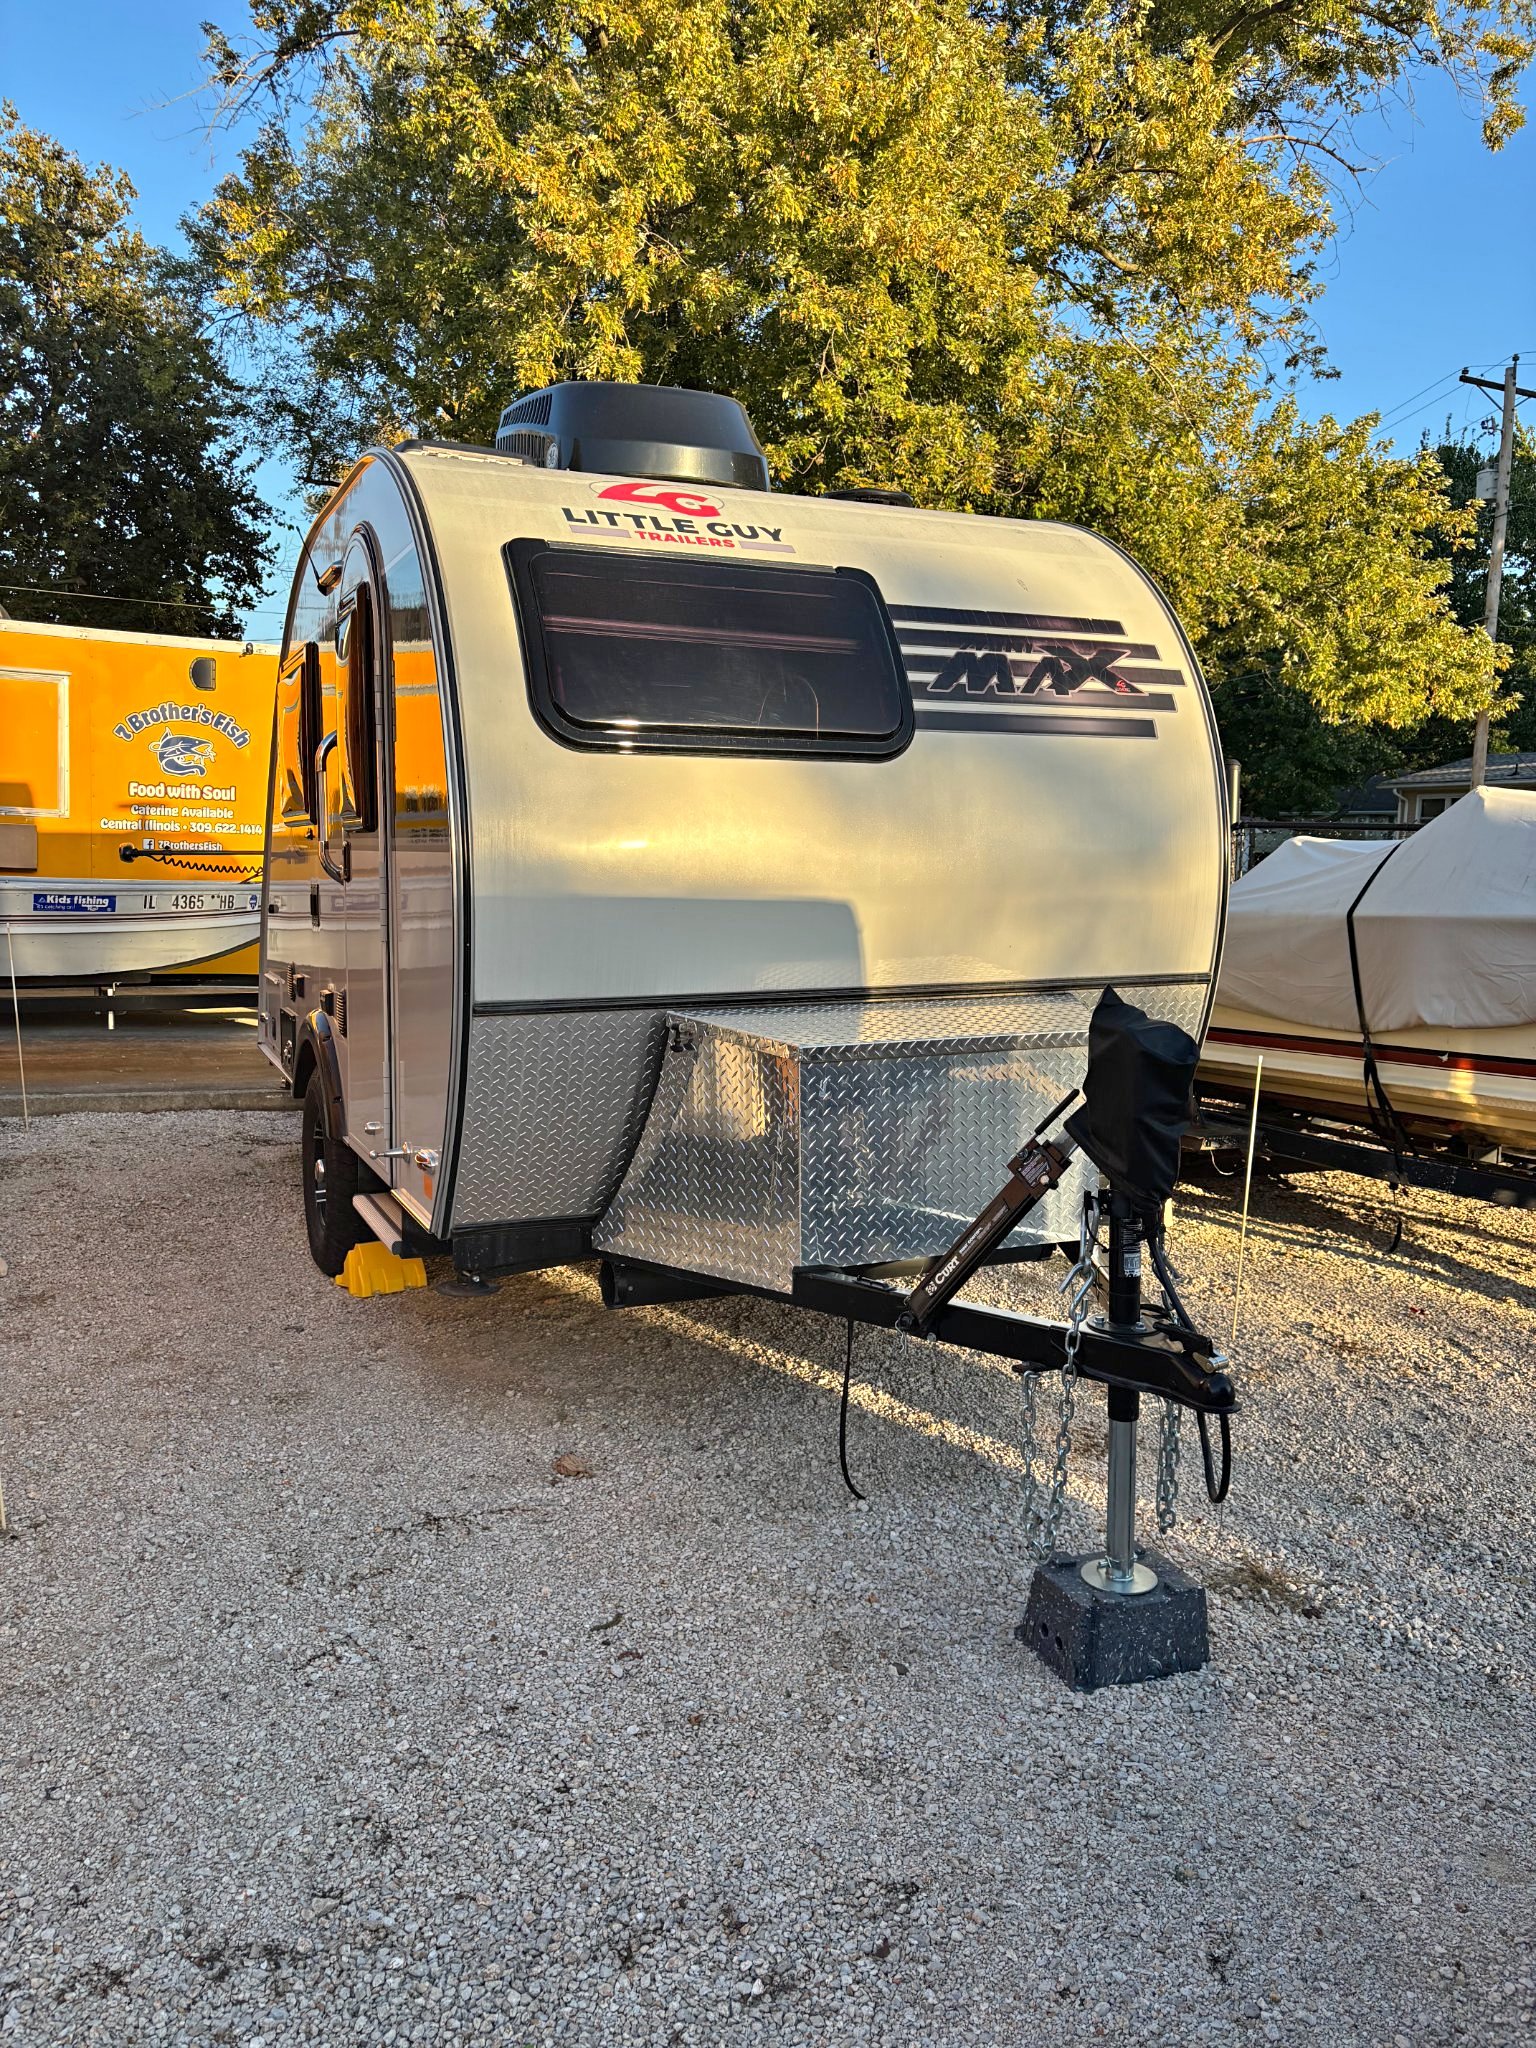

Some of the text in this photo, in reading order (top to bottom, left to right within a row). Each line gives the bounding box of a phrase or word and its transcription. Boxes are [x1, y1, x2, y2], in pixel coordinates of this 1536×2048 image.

[561, 507, 782, 542] LITTLE GUY
[634, 531, 735, 548] TRAILERS
[927, 645, 1150, 696] MAX
[113, 700, 252, 748] 7 Brother's Fish
[129, 782, 237, 801] Food with Soul
[131, 804, 234, 819] Catering Available
[100, 818, 142, 830] Central
[189, 822, 263, 835] 309.622.1414
[158, 840, 223, 851] 7BrothersFish
[46, 894, 109, 907] Kids fishing
[143, 895, 155, 909] IL
[172, 895, 204, 909] 4365
[220, 895, 235, 909] HB
